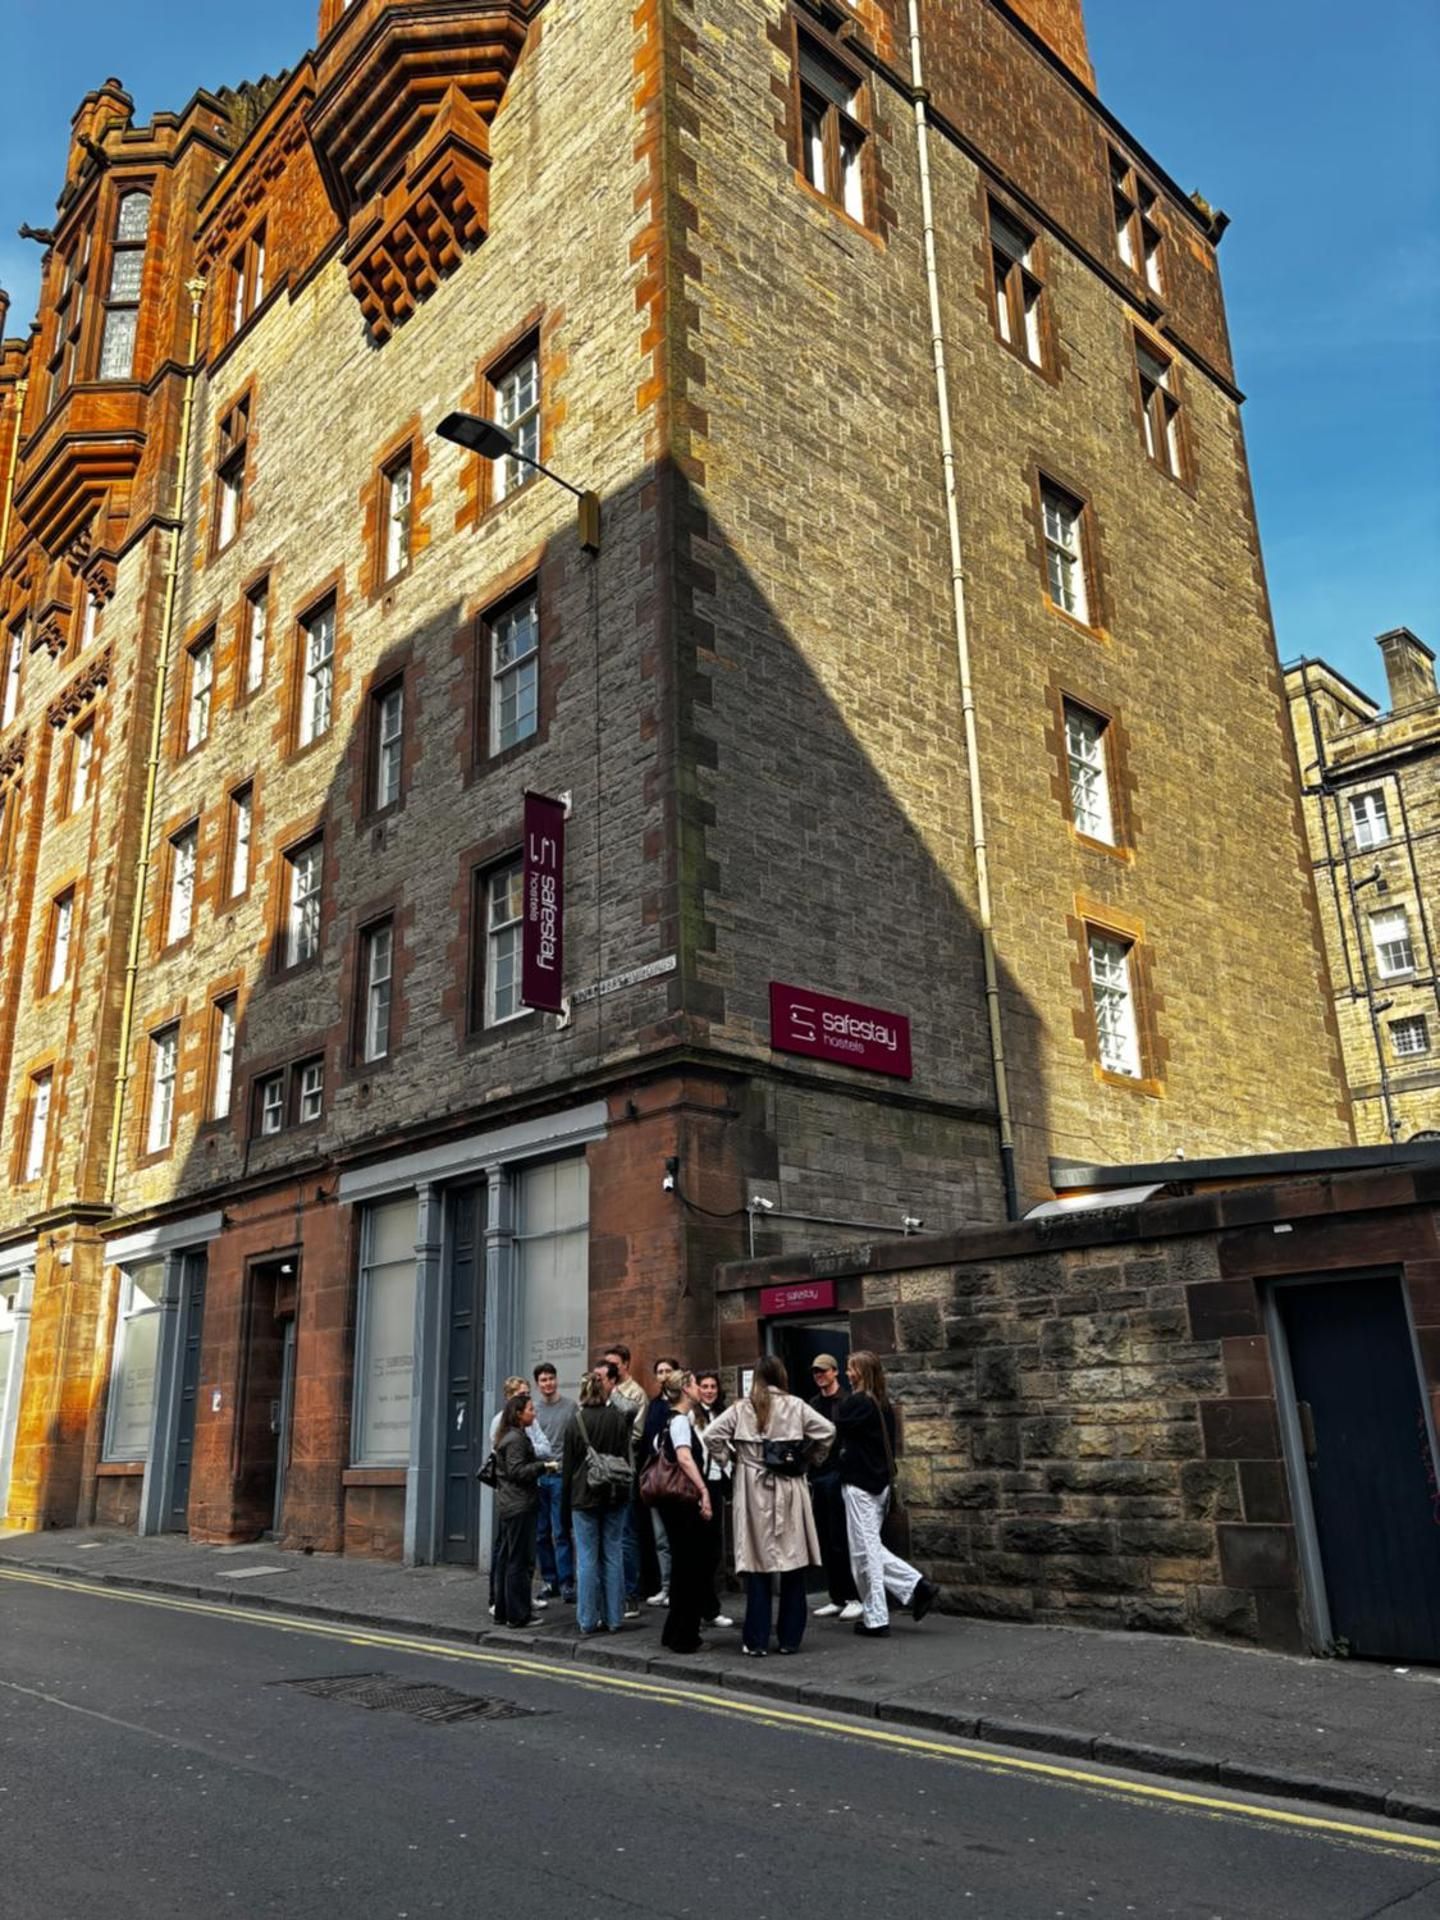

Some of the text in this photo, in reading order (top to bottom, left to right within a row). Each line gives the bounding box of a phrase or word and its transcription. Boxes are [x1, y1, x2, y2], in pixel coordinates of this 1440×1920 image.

[529, 872, 538, 922] hostels
[536, 875, 556, 971] safestay
[822, 1012, 897, 1051] safestay
[823, 1034, 865, 1054] hostels
